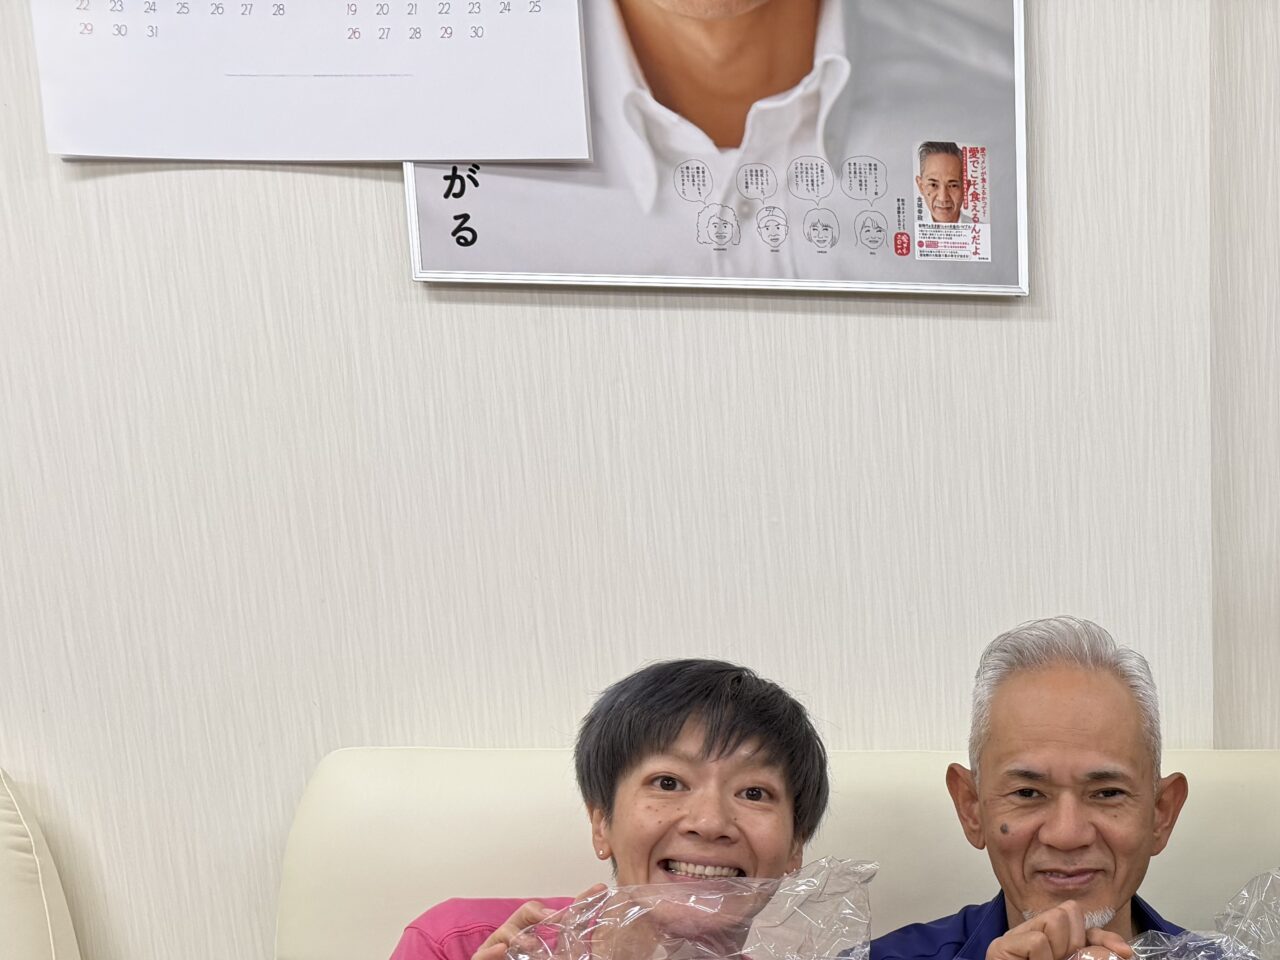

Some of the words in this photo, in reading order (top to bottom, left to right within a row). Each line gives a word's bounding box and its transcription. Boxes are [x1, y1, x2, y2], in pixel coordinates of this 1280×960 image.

[75, 0, 90, 11] 22
[109, 0, 124, 12] 23
[143, 1, 157, 13] 24
[176, 2, 190, 14] 25
[210, 2, 224, 15] 26
[240, 4, 253, 16] 27
[272, 4, 285, 16] 28
[346, 3, 358, 15] 19
[376, 3, 390, 15] 20
[407, 3, 418, 15] 21
[438, 2, 451, 15] 22
[468, 2, 481, 14] 23
[499, 1, 511, 14] 24
[528, 0, 542, 13] 25
[79, 22, 93, 35] 29
[112, 24, 128, 37] 30
[146, 25, 159, 38] 31
[347, 27, 361, 40] 26
[378, 27, 391, 40] 27
[409, 27, 422, 40] 28
[440, 26, 453, 39] 29
[469, 26, 484, 39] 30
[443, 163, 480, 247] がる
[968, 146, 981, 256] 愛でこそ食えるんだよ
